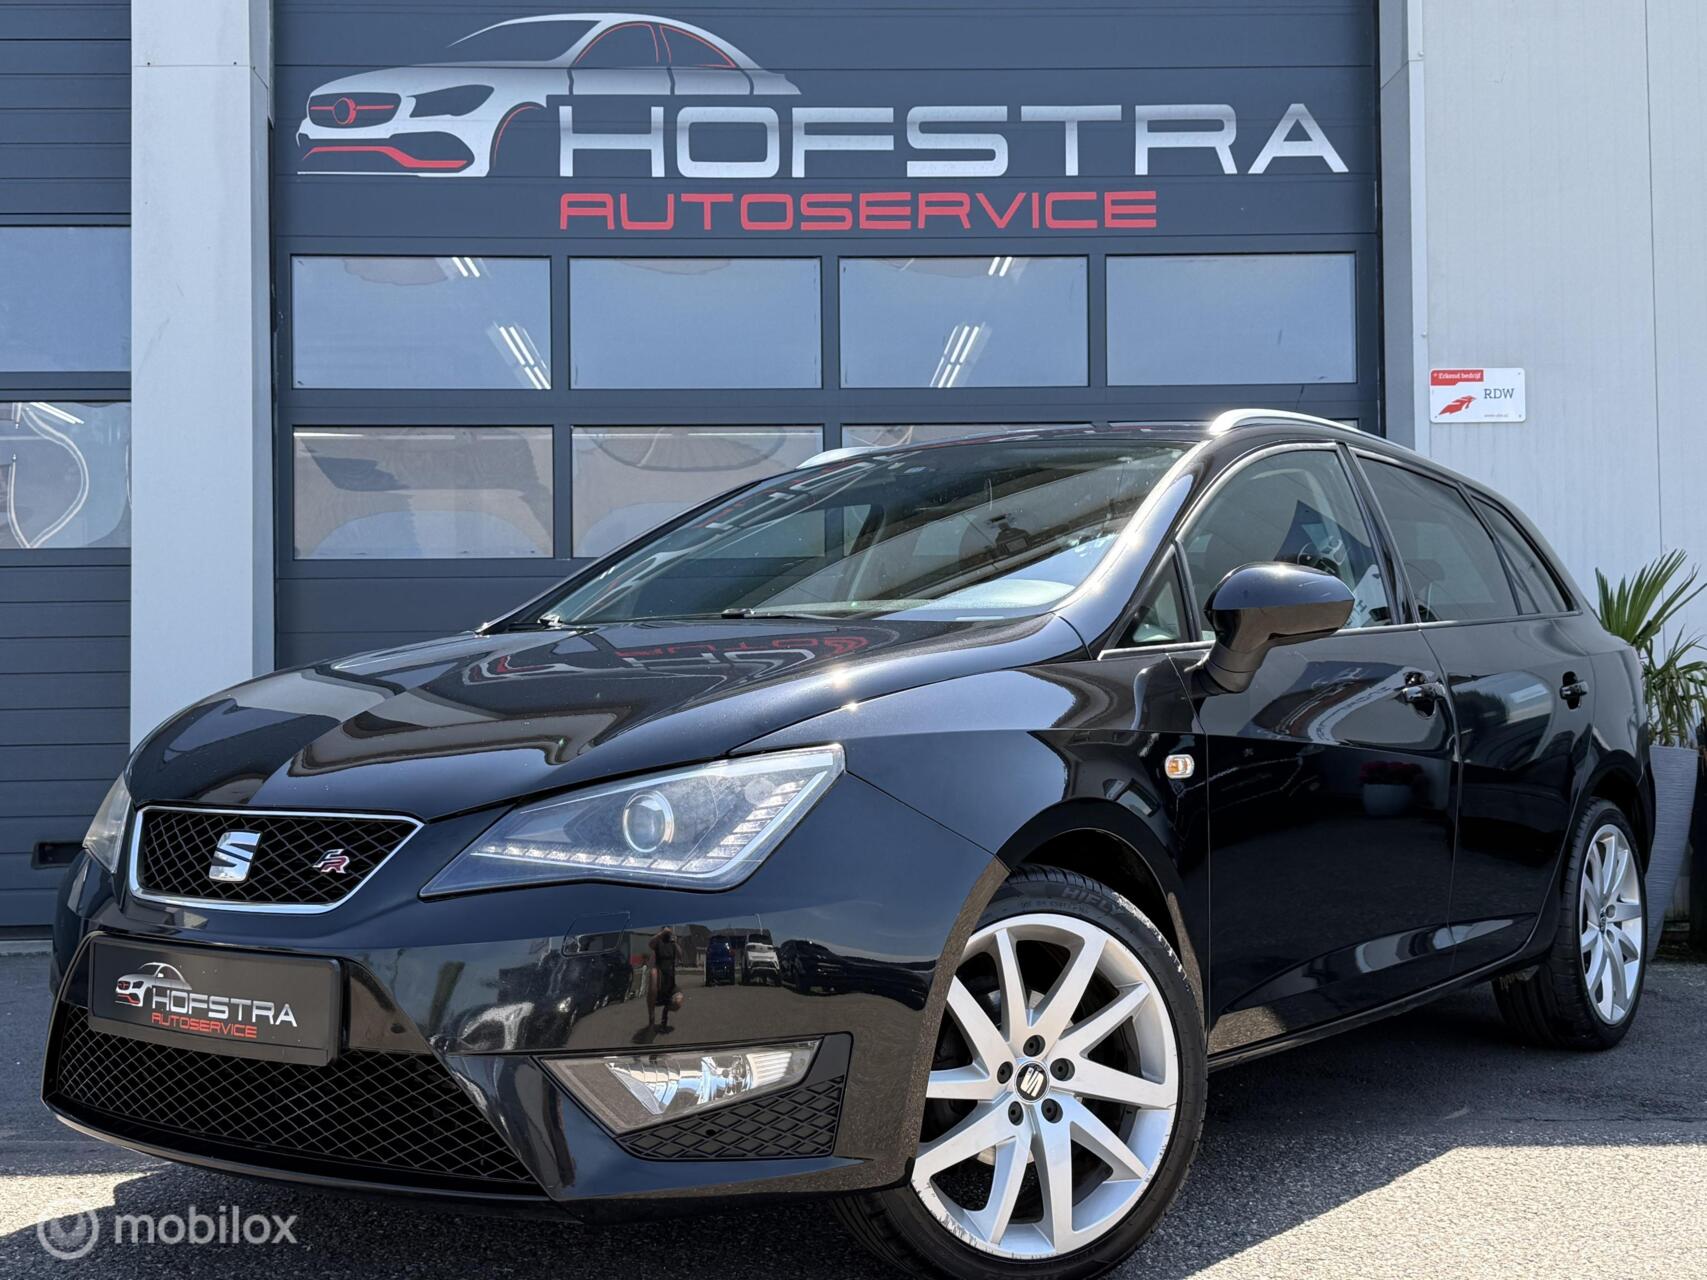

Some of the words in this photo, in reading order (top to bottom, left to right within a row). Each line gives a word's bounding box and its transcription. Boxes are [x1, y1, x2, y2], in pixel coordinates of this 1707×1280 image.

[559, 102, 1350, 178] HOFSTRA
[559, 190, 1158, 230] AUTOSERVICE
[1484, 388, 1514, 399] RDW
[151, 987, 298, 1027] HOFSTRA
[151, 1012, 257, 1039] AUTOSERVICE
